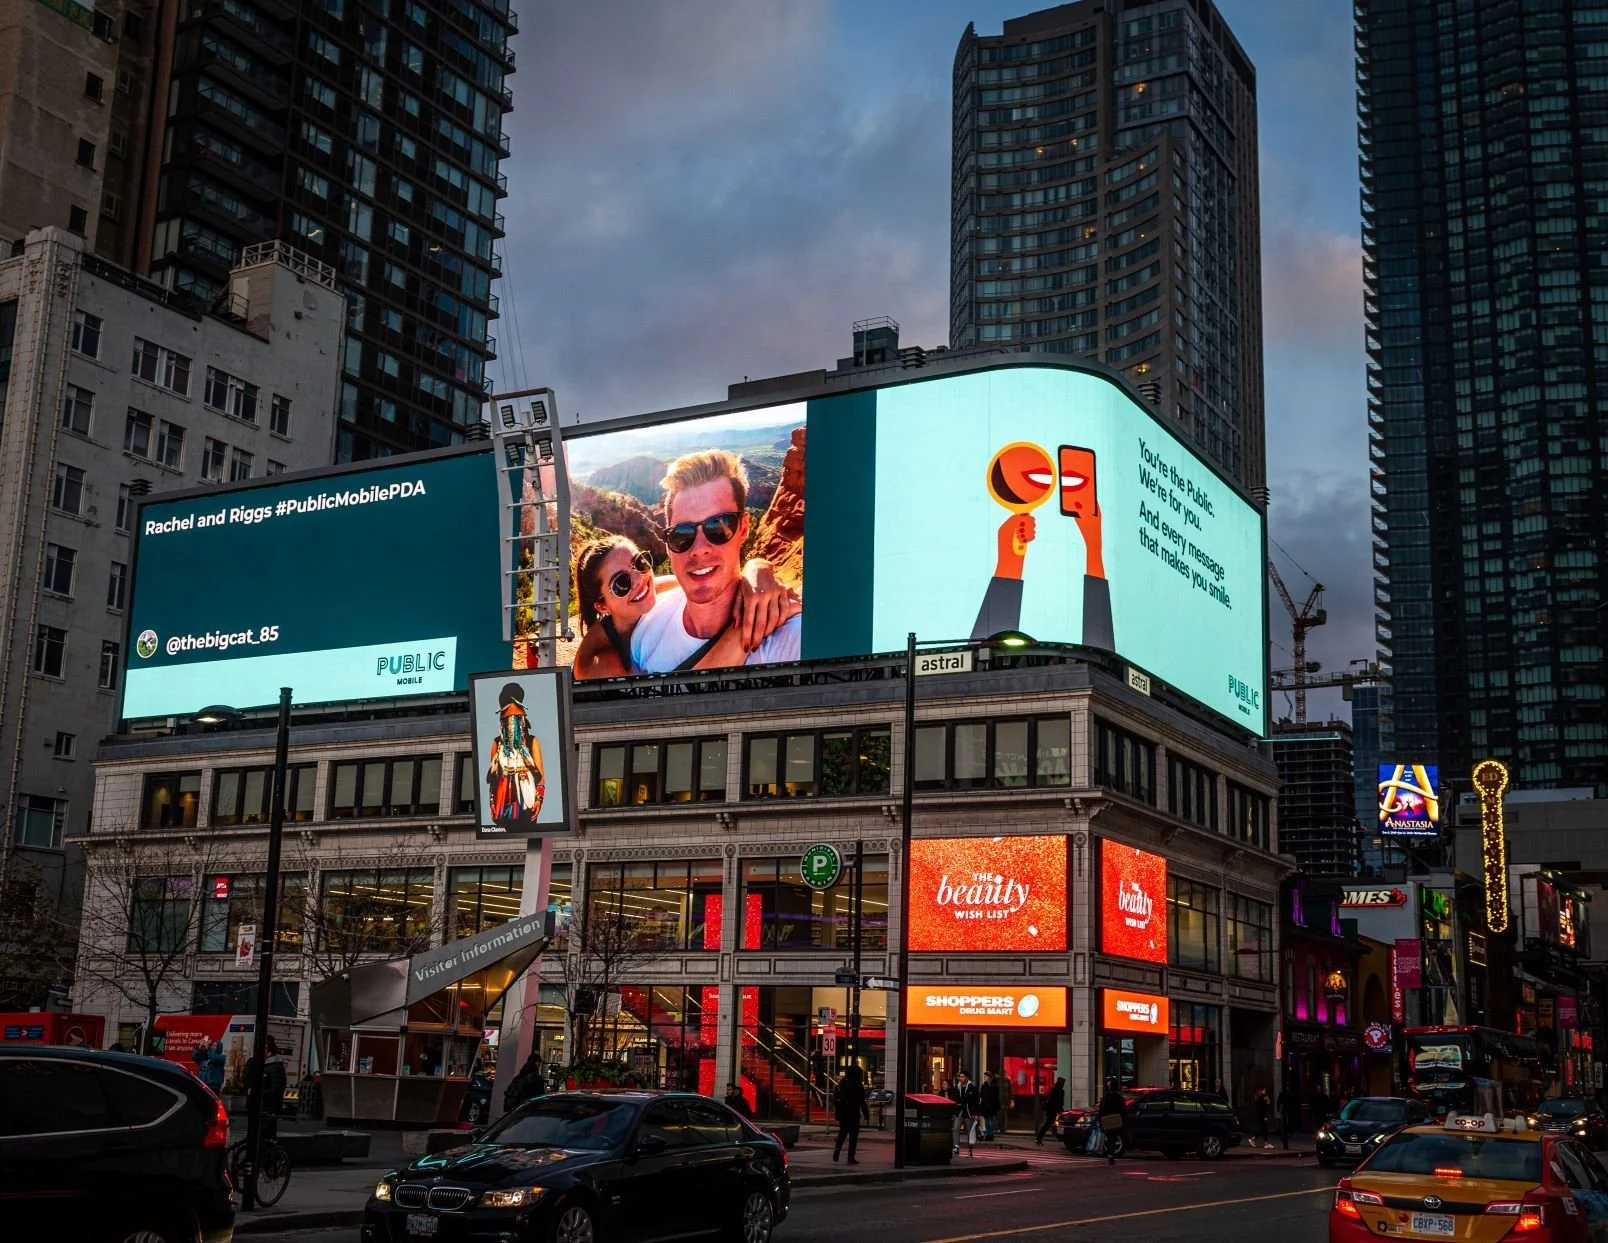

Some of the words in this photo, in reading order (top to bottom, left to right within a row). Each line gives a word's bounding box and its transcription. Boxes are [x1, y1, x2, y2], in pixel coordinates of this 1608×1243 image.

[1138, 437, 1168, 478] You're
[1170, 466, 1185, 492] the
[1187, 479, 1215, 518] Public.
[1138, 464, 1167, 502] We're
[1169, 489, 1182, 514] for
[1184, 505, 1202, 532] you.
[145, 514, 194, 536] Rachel
[197, 508, 225, 528] and
[230, 504, 272, 524] Riggs
[276, 480, 426, 516] #PublicMobilePDA
[1138, 500, 1159, 530] And
[1161, 520, 1187, 556] every
[1189, 542, 1225, 582] message
[1139, 526, 1159, 557] that
[1161, 546, 1190, 579] makes
[1191, 568, 1207, 589] you
[1209, 582, 1232, 610] smile.
[166, 626, 279, 655] @thebigcat_85
[377, 651, 446, 676] PUBLIC
[921, 654, 964, 671] astral
[396, 676, 422, 686] MOBILE
[1132, 673, 1148, 692] astral
[1228, 674, 1259, 710] PUBLIC
[1482, 773, 1498, 782] ED
[1384, 817, 1434, 829] ANASTASIA
[804, 846, 837, 862] MUNICIPAL
[813, 856, 827, 872] P
[803, 869, 836, 886] PARKING
[973, 873, 994, 882] THE
[937, 874, 1029, 912] beauty
[1118, 880, 1152, 924] beauty
[954, 910, 984, 919] WISH
[986, 910, 1009, 919] LIST
[415, 956, 458, 981] Visitor
[461, 920, 540, 962] Information
[926, 996, 1014, 1007] SHOPPERS
[1116, 1000, 1149, 1014] SHOPPERS
[824, 1038, 834, 1052] 30
[1455, 1119, 1485, 1128] co-op
